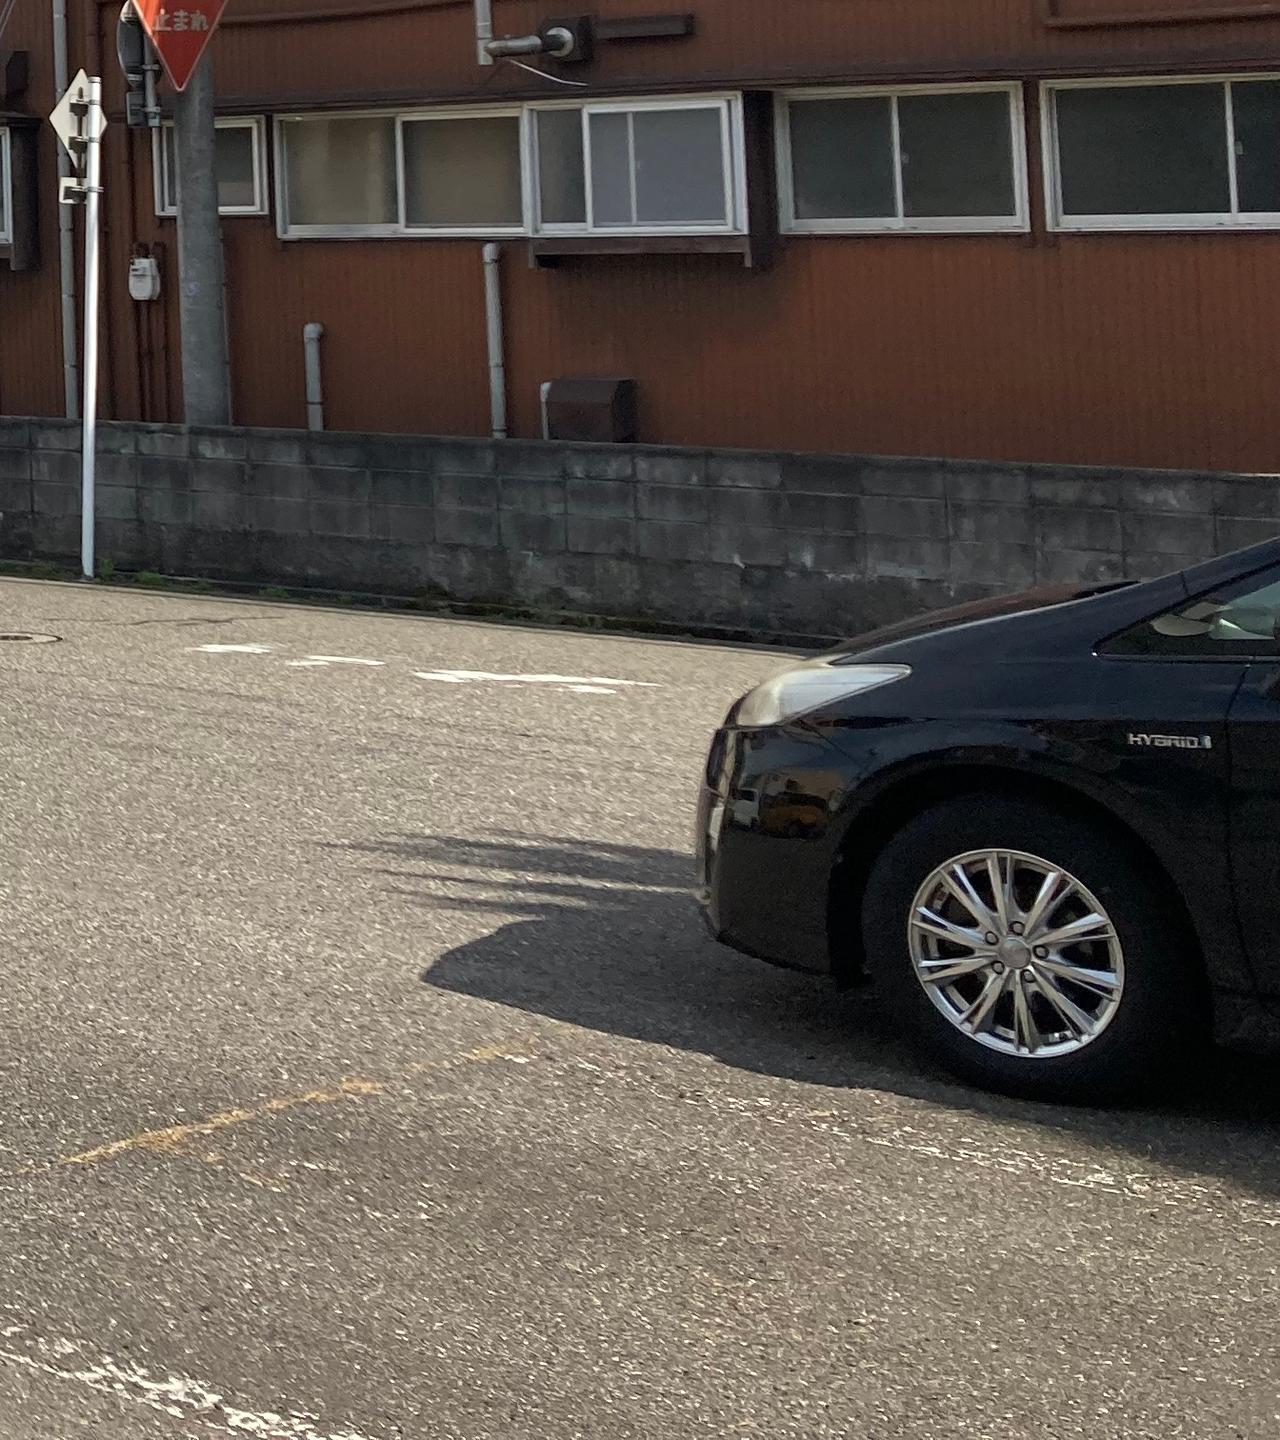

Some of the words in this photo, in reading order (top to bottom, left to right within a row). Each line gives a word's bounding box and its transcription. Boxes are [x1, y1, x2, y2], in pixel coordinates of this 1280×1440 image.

[153, 8, 209, 32] 止まれ
[1127, 732, 1199, 749] HYBRID
